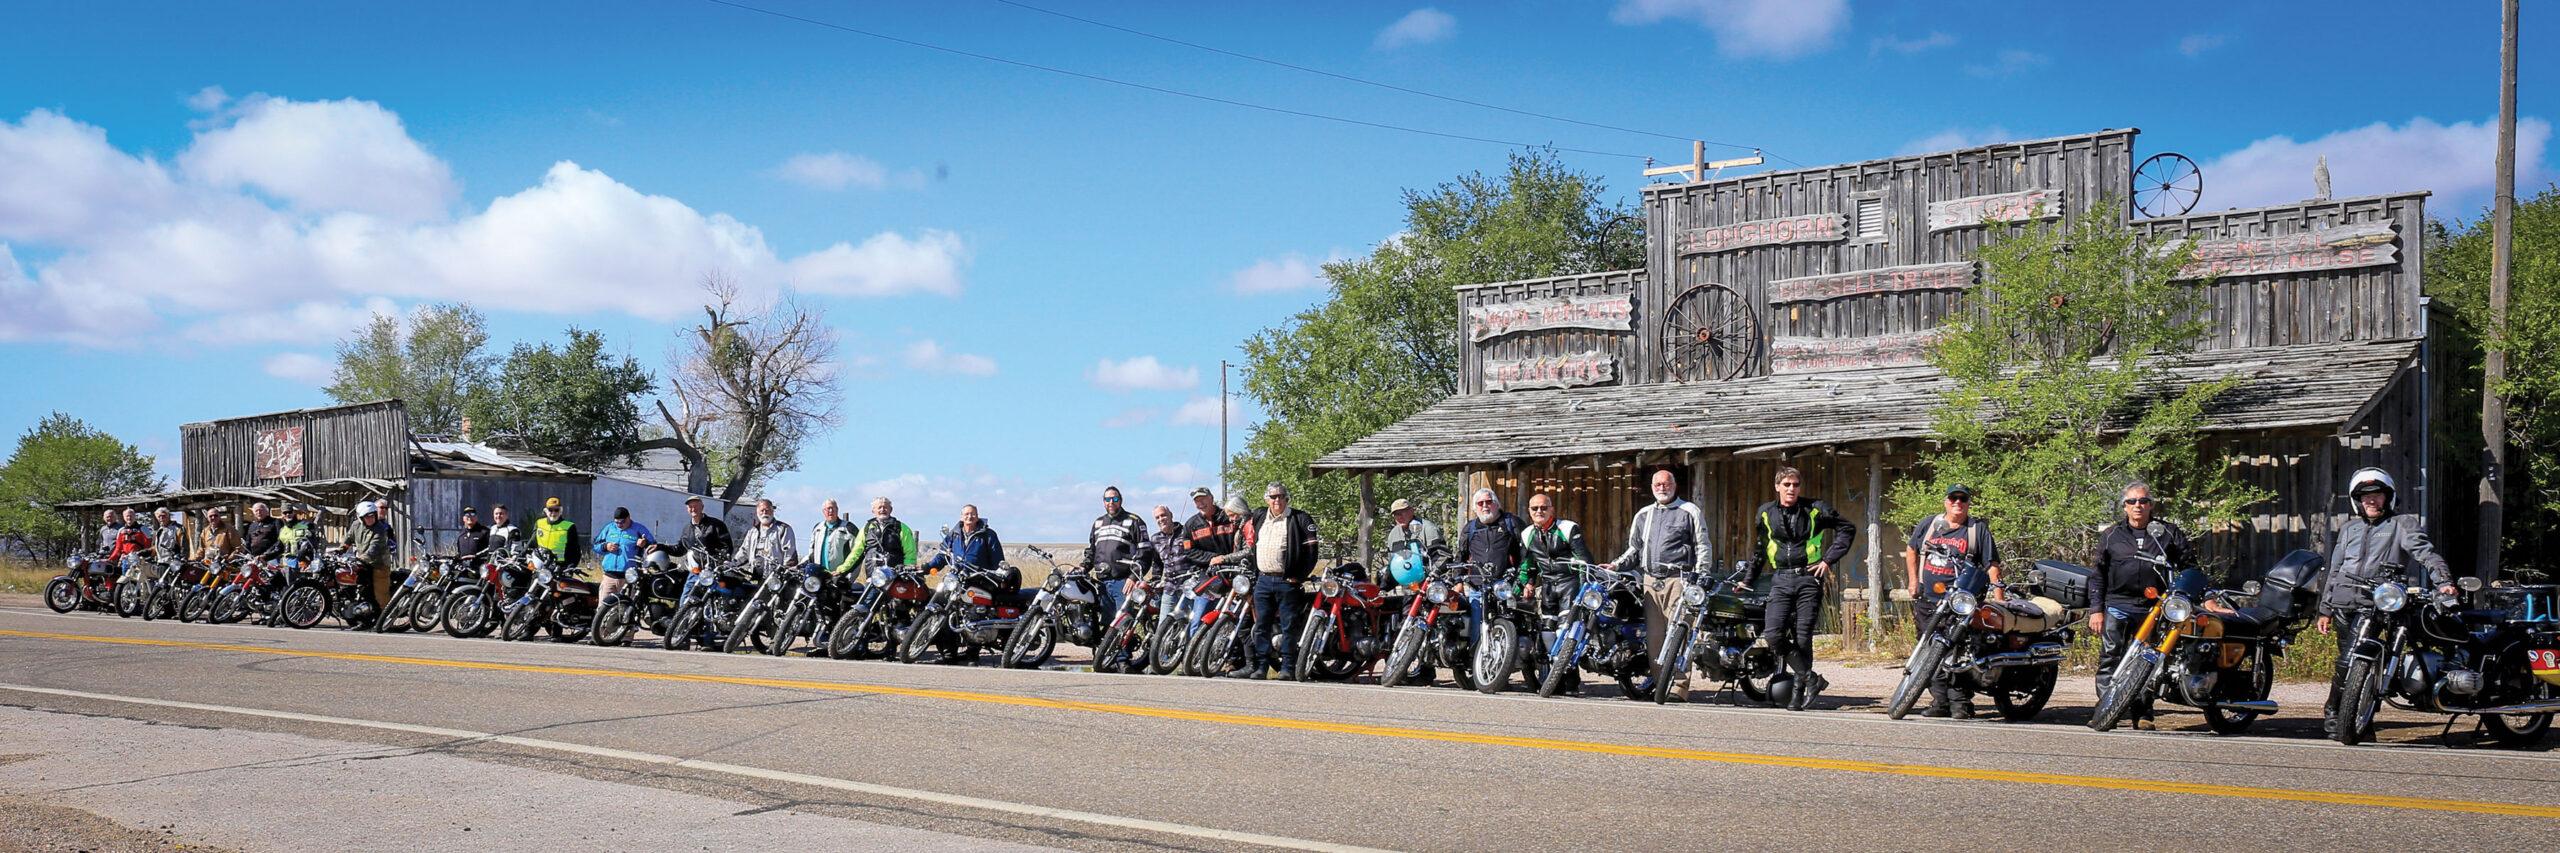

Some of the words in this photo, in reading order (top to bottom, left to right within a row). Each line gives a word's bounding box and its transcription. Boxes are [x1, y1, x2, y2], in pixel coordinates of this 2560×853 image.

[1945, 193, 2043, 224] STORE
[1689, 217, 1832, 249] LONGHORN
[2199, 234, 2330, 257] GENERAL
[1474, 309, 1529, 331] LAKOTA
[1542, 299, 1628, 324] ARTIFACTS
[1774, 343, 1809, 357] ASHES
[1811, 342, 1825, 353] TO
[1827, 340, 1864, 353] ASHES
[1878, 336, 1910, 349] DUST
[1497, 360, 1600, 384] BEADWORK
[1786, 357, 1802, 370] WE
